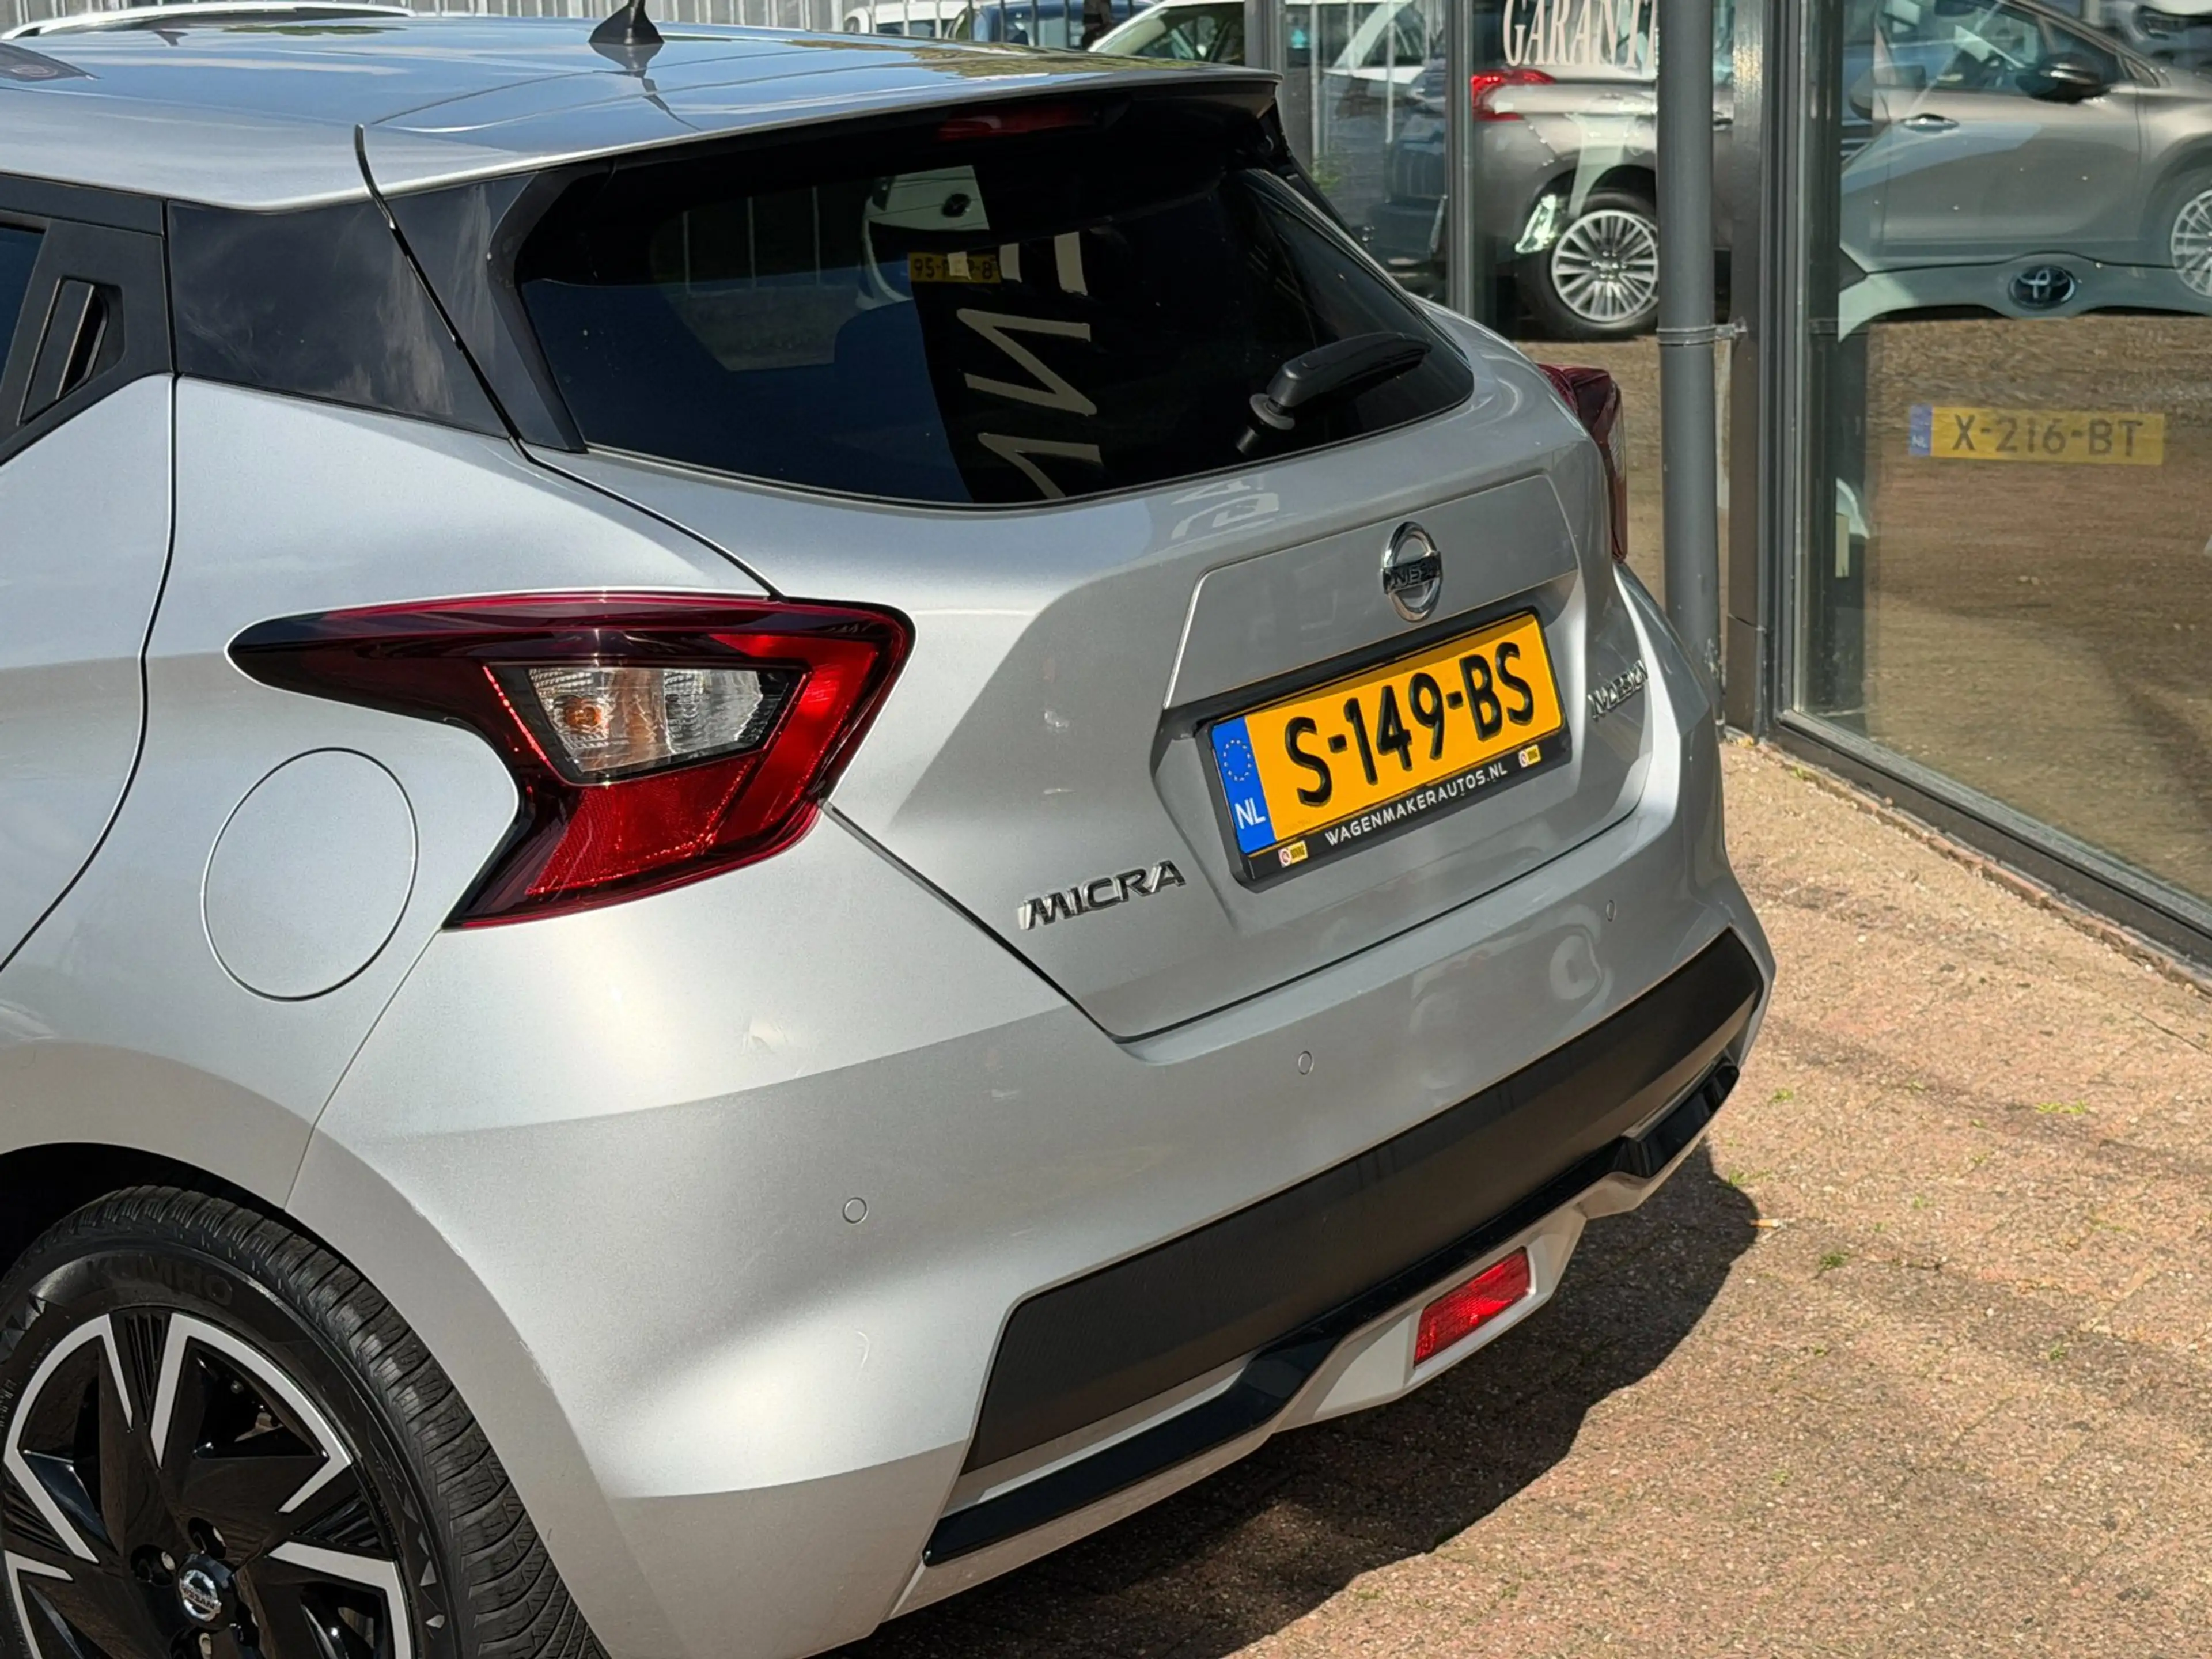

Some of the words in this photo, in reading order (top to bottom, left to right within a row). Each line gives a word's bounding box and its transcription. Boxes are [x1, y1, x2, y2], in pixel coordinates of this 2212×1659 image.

[1952, 414, 2143, 456] X-216-BT
[1285, 642, 1535, 807] S-149-BS
[1234, 797, 1266, 830] NL
[1325, 762, 1508, 846] WAGENMAKERAUTOS.NL
[1017, 860, 1186, 930] MICRA
